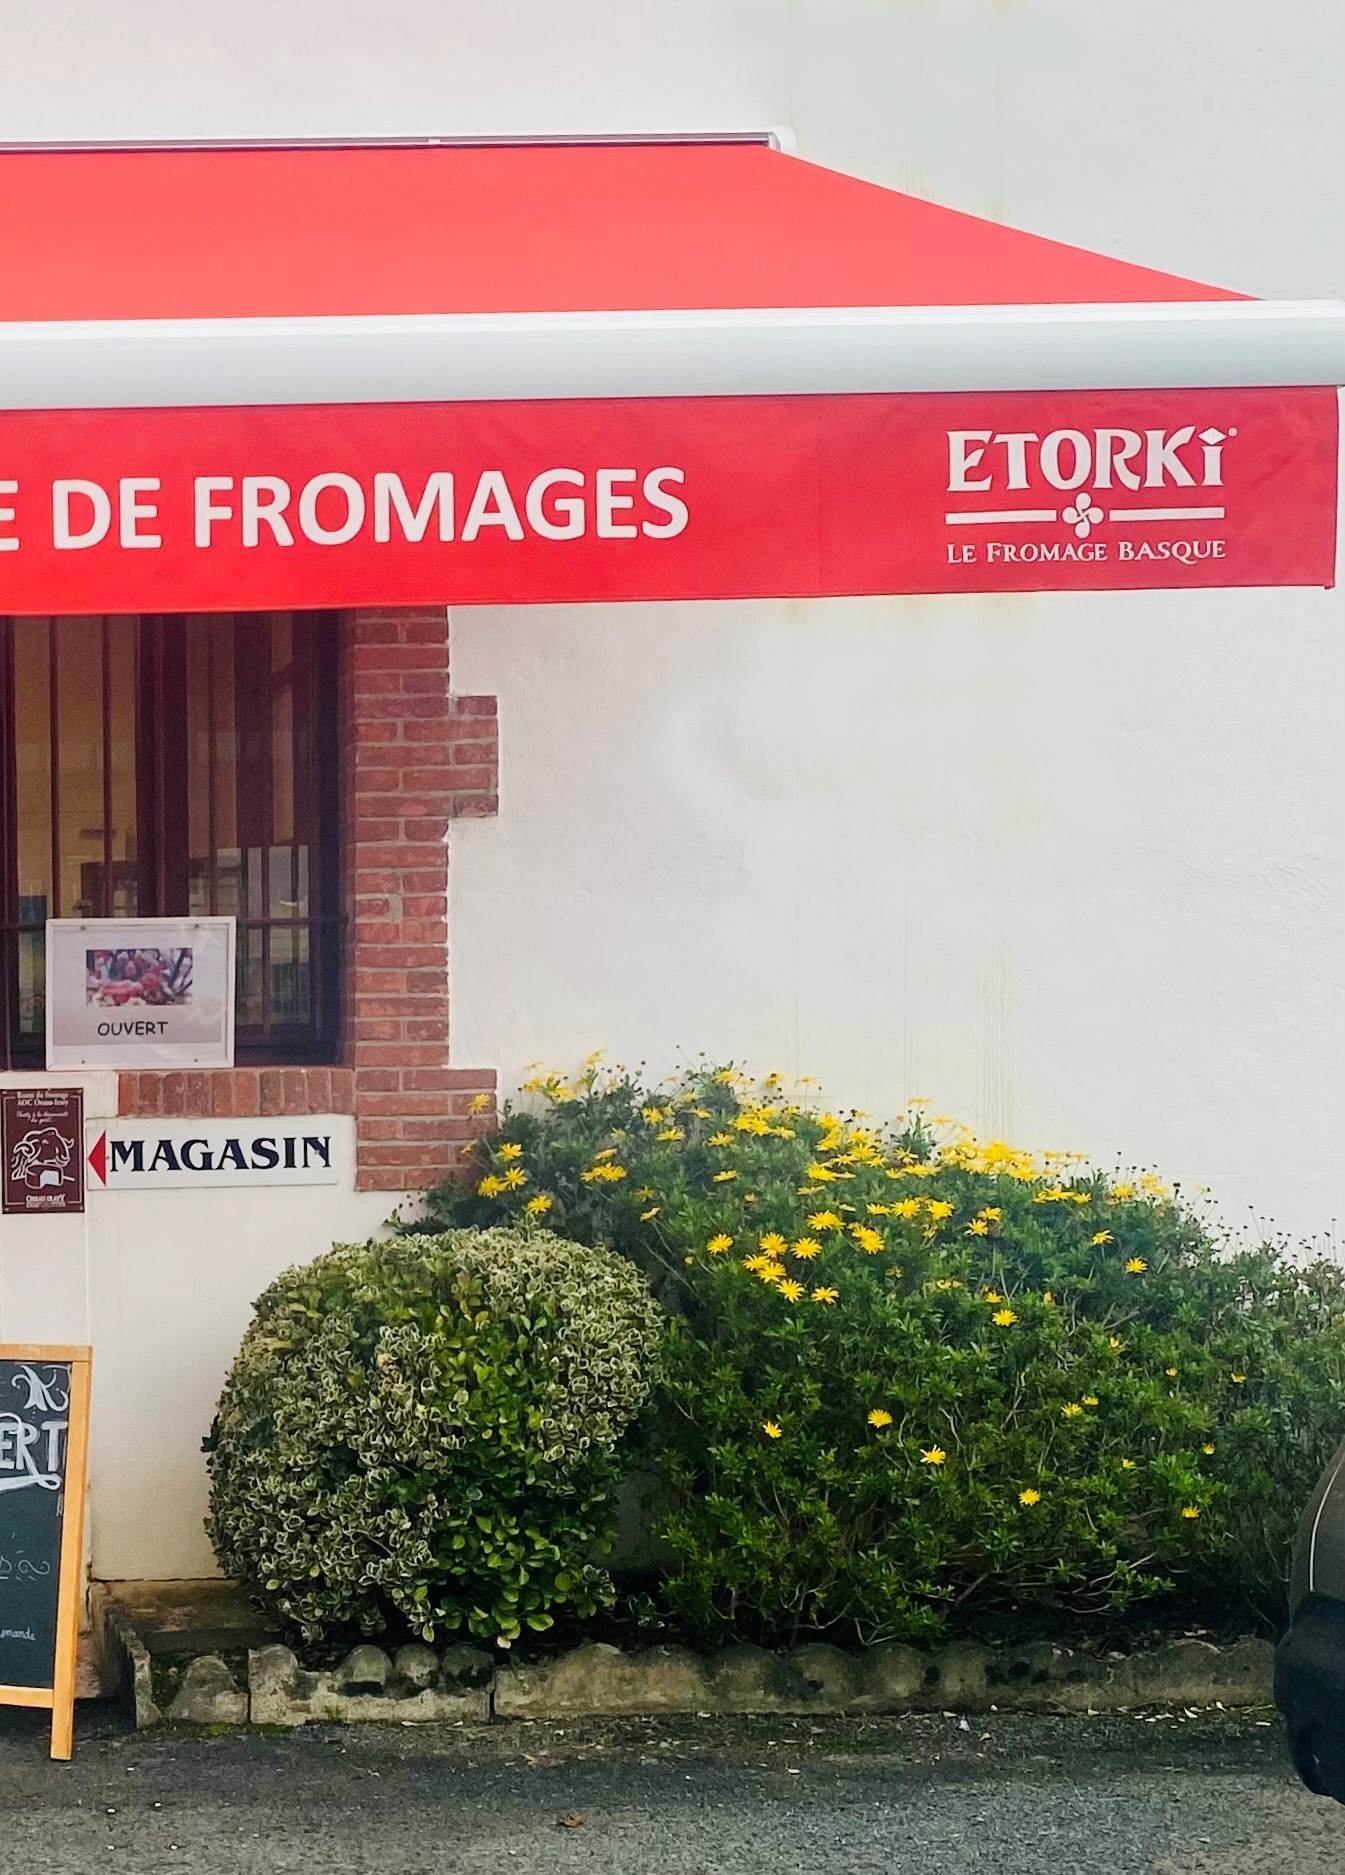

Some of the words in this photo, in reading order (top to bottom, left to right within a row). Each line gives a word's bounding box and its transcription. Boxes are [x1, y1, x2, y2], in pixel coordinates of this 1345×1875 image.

[53, 477, 162, 550] DE
[193, 467, 689, 548] FROMAGES
[947, 543, 977, 563] LE
[987, 542, 1107, 563] FROMAGE
[1118, 540, 1226, 565] BASQUE
[97, 1021, 168, 1037] OUVERT
[109, 1136, 332, 1173] MAGASIN
